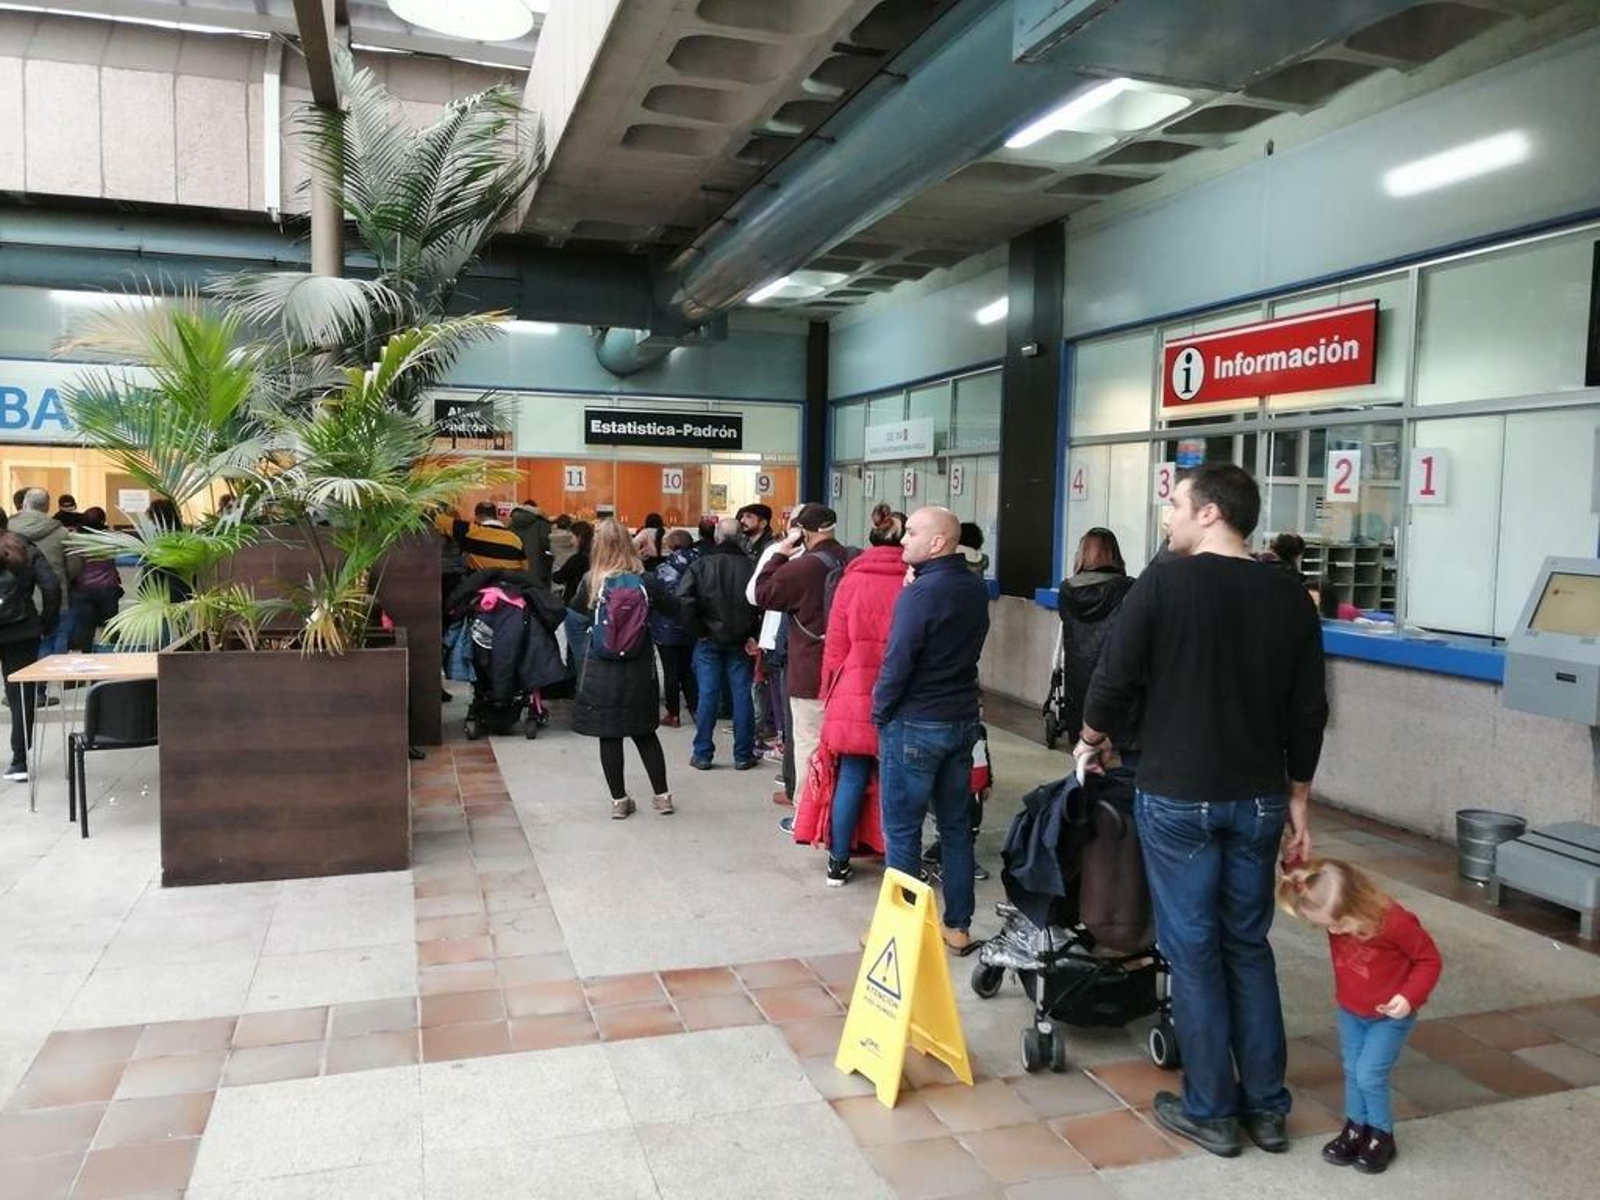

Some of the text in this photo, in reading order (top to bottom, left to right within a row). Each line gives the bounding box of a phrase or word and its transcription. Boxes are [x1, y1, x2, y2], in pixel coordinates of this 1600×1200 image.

[1214, 335, 1360, 380] Información
[566, 470, 585, 487] 11
[663, 473, 682, 489] 10
[758, 475, 771, 493] 9
[905, 471, 912, 492] 6
[952, 467, 961, 490] 5
[1073, 468, 1085, 495] 4
[1158, 469, 1171, 498] 3
[1333, 458, 1354, 495] 2
[1420, 456, 1436, 496] 1
